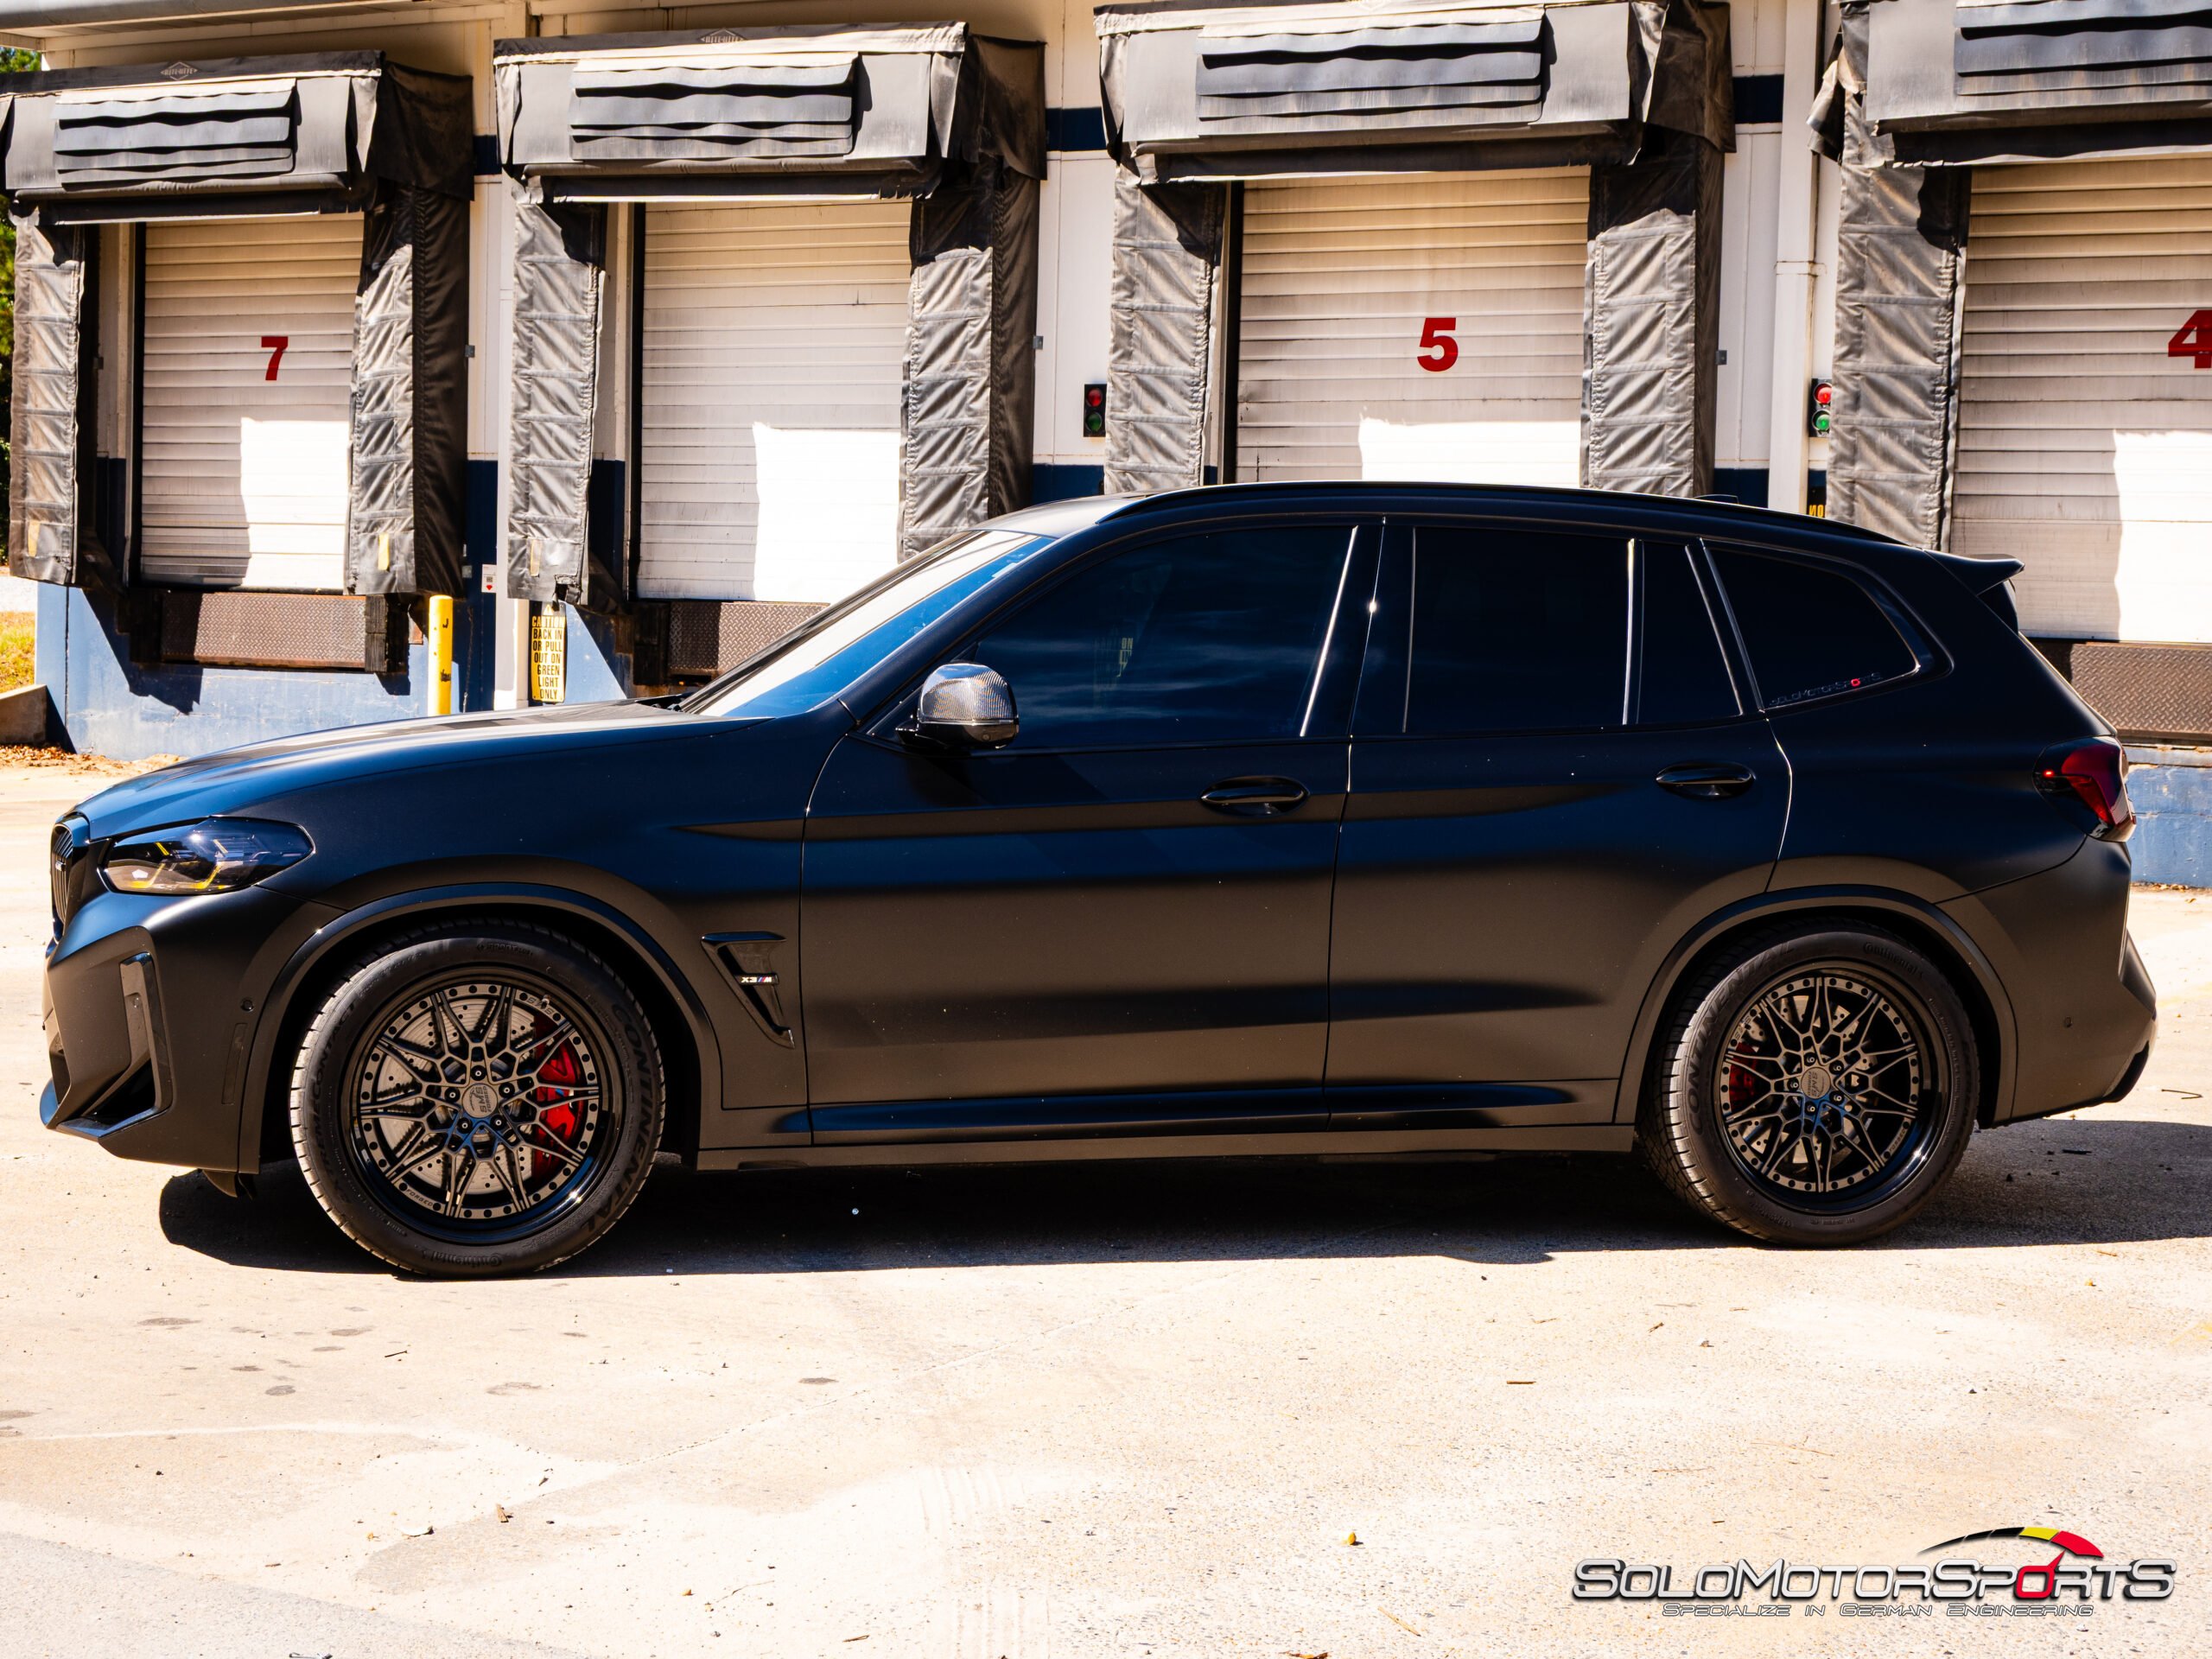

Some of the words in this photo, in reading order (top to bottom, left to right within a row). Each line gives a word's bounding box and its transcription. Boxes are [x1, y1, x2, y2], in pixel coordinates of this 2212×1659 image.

[1417, 317, 1459, 372] 5
[2168, 309, 2212, 369] 4
[261, 335, 289, 381] 7
[531, 615, 566, 627] CAUTION
[533, 628, 551, 639] BACK
[555, 629, 563, 639] IN
[532, 640, 542, 652] OR
[545, 640, 563, 652] PULL
[534, 652, 548, 664] OUT
[551, 653, 561, 664] ON
[537, 664, 560, 676] GREEN
[538, 677, 559, 688] LIGHT
[539, 689, 557, 700] ONLY
[581, 1001, 654, 1233] CONTINENTAL
